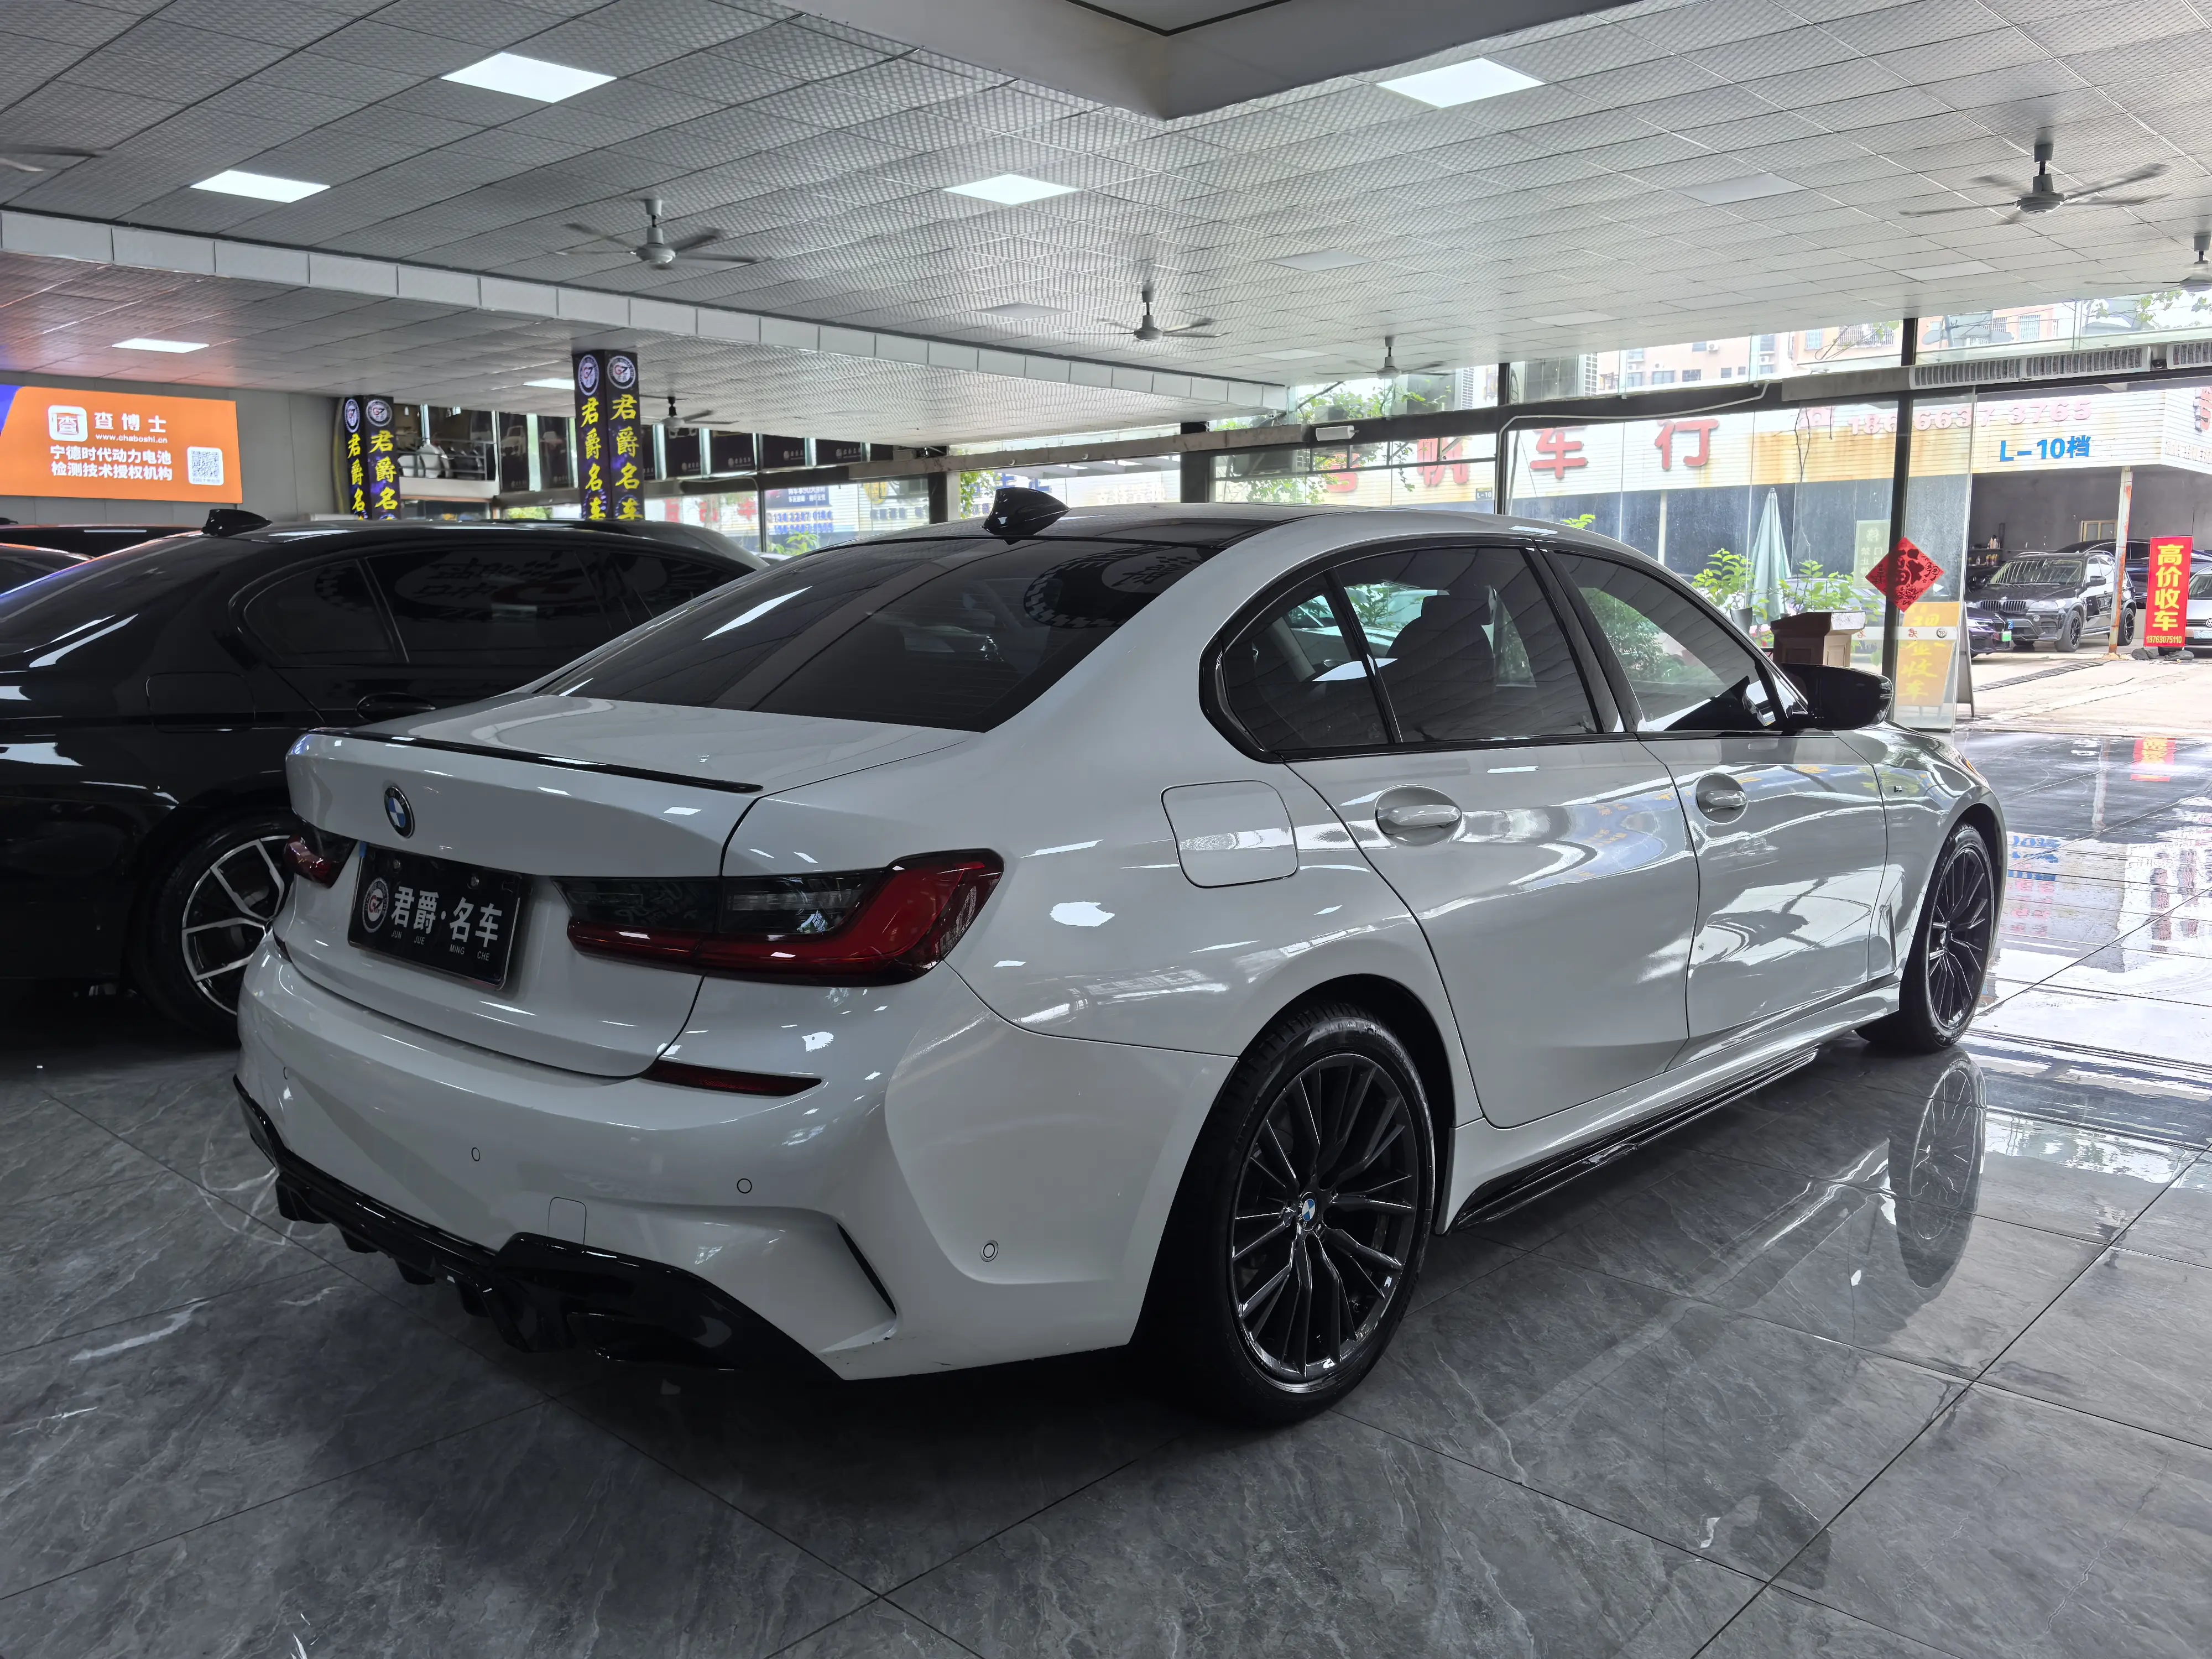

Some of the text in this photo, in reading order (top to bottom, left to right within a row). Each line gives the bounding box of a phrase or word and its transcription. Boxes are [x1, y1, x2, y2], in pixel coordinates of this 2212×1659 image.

[94, 411, 167, 434] 查博士
[2007, 399, 2092, 425] 3765
[95, 433, 168, 444] www.chaboshi.cn
[2000, 435, 2091, 462] L-10档
[50, 445, 172, 465] 宁德时代动力电池
[581, 397, 607, 520] 君爵名车
[610, 394, 644, 520] 君爵名车
[51, 462, 173, 481] 检测技术授权机构
[347, 433, 366, 520] 君爵名
[368, 430, 398, 520] 君爵名
[2152, 544, 2184, 632] 高价收车
[391, 930, 490, 961] JUN JUE MING CHE
